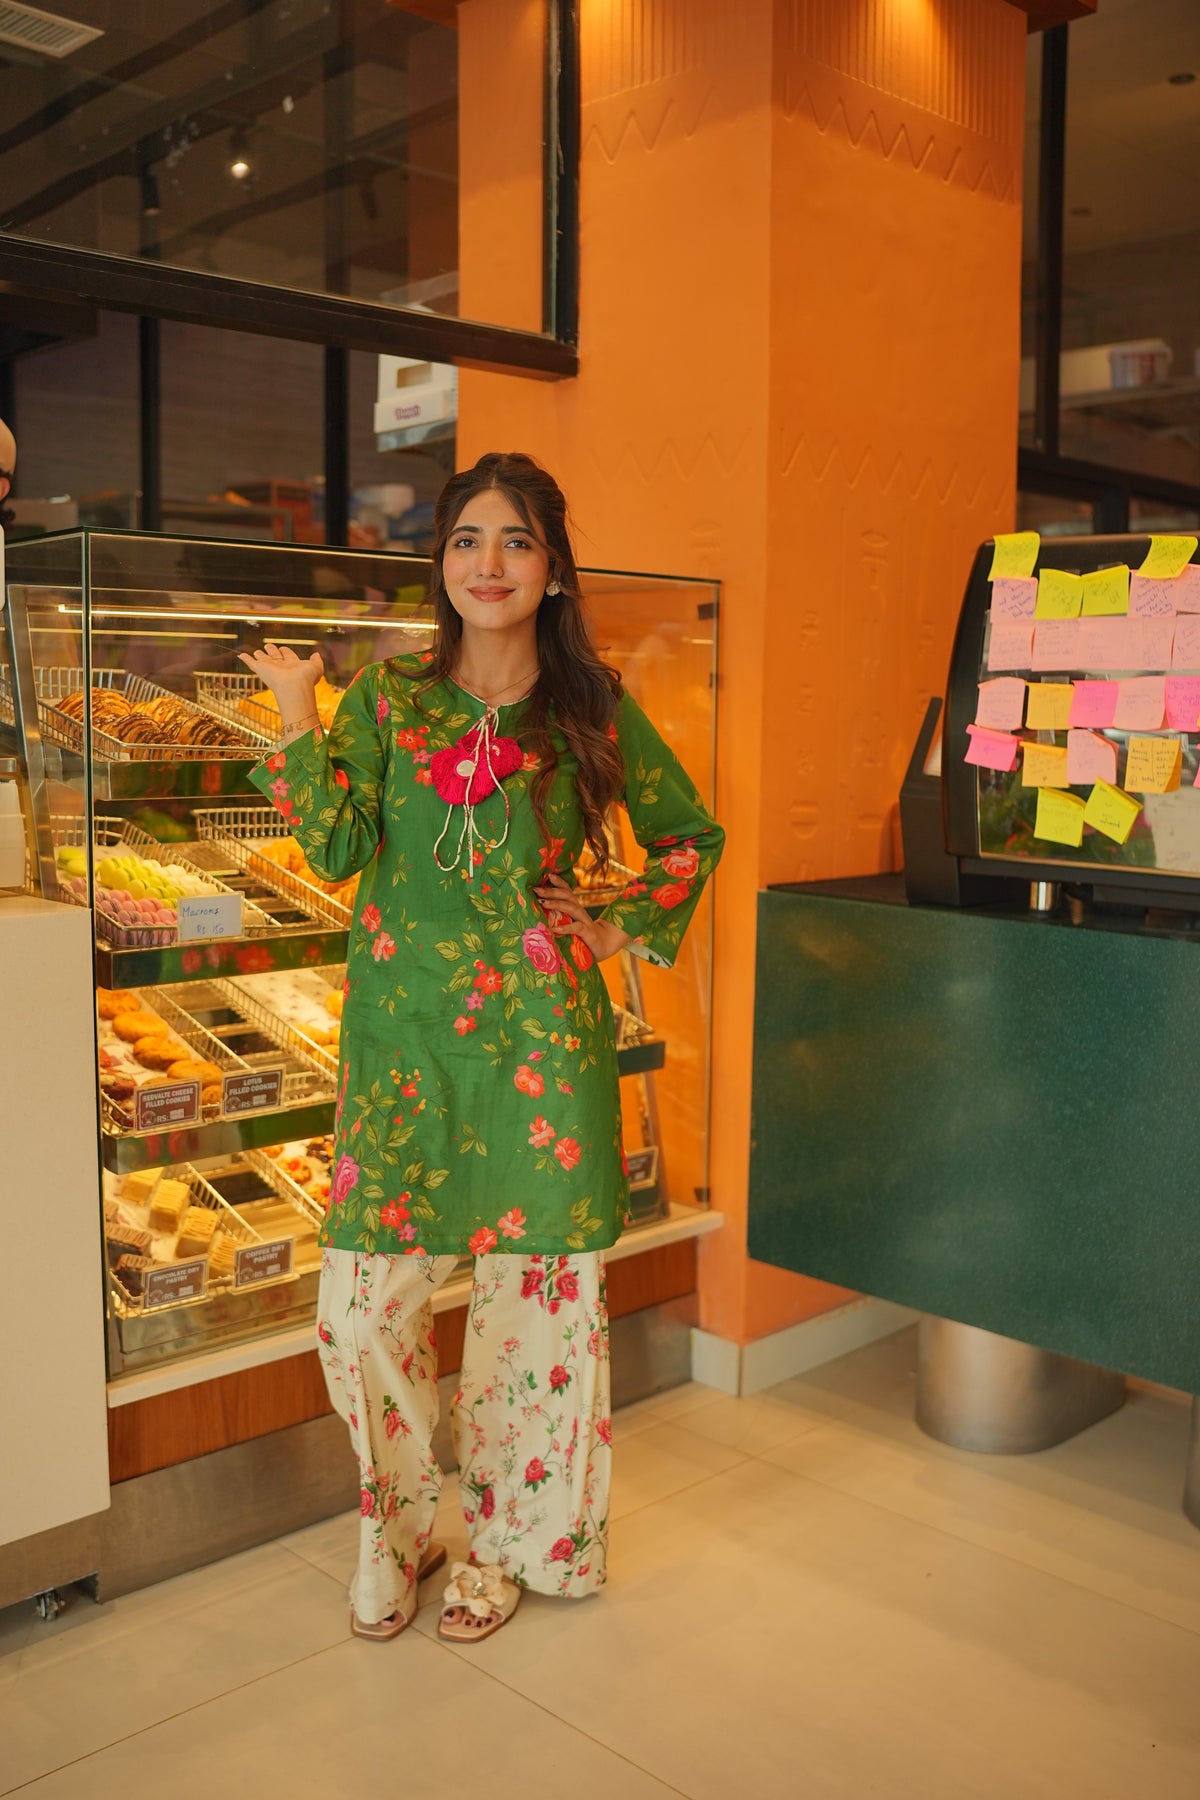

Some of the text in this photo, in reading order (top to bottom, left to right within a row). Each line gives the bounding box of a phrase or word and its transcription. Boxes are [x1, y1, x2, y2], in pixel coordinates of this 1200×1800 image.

[243, 1077, 263, 1087] LOTUS
[171, 1087, 194, 1097] CHEESE
[229, 1082, 278, 1096] FILLED COOKIES
[145, 1094, 191, 1109] FILLED COOKIES
[253, 1252, 278, 1264] PASTRY
